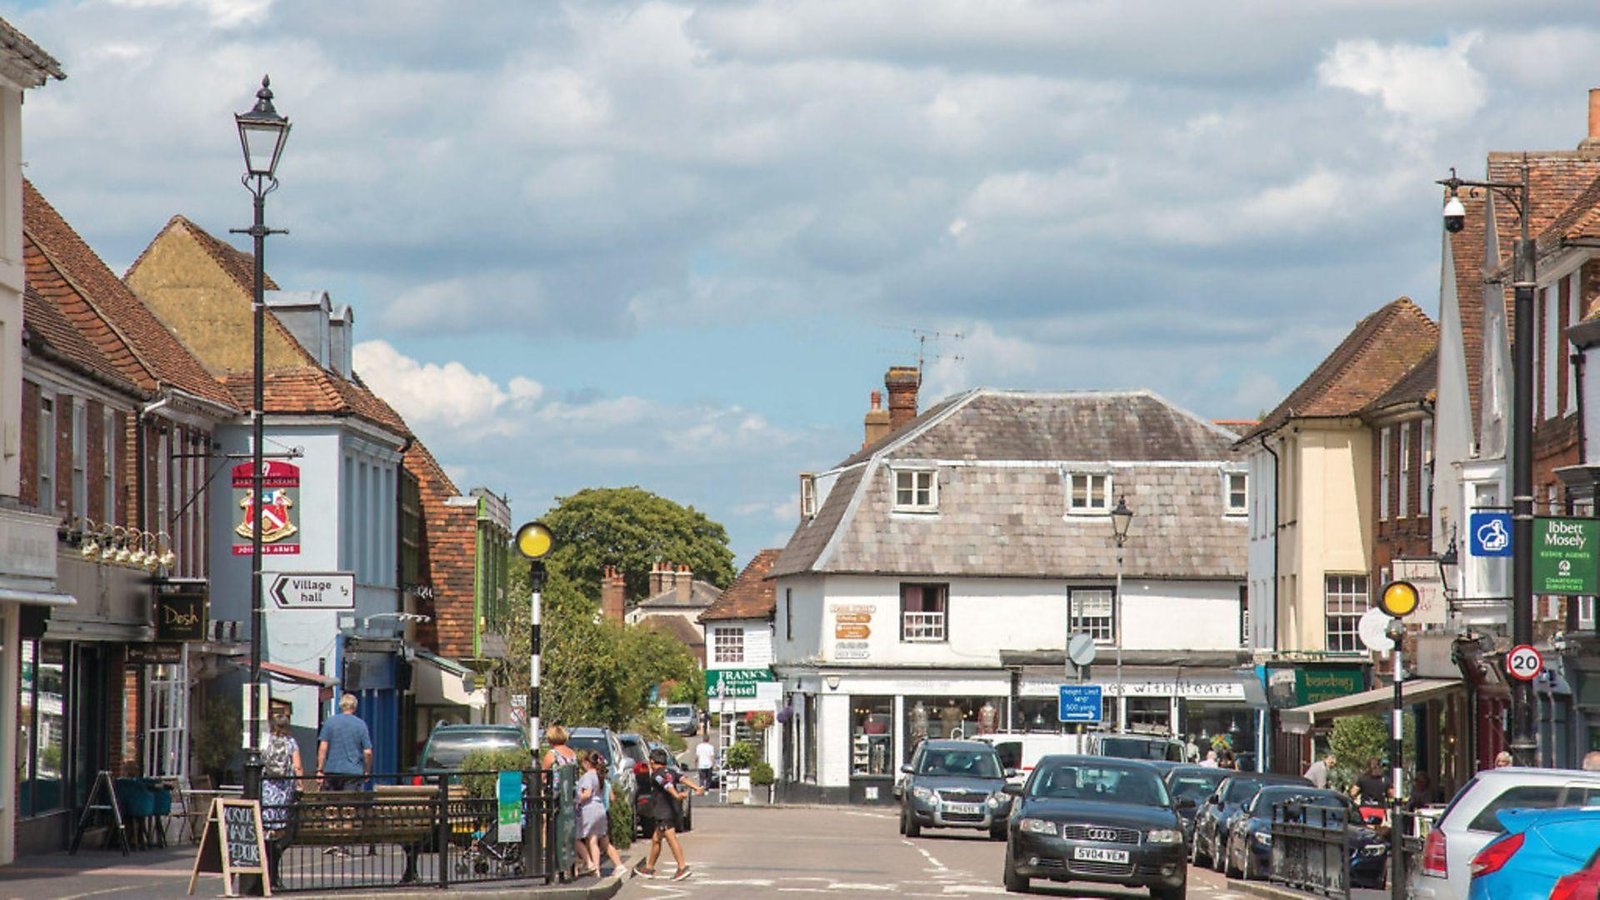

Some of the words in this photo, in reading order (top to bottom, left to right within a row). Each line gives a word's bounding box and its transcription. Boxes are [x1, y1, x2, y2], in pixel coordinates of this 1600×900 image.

[1548, 521, 1584, 535] Ibbett
[1544, 532, 1587, 551] Mosely
[293, 580, 332, 592] Village
[301, 592, 323, 602] hall
[1513, 655, 1538, 670] 20
[1135, 681, 1173, 694] with
[1305, 673, 1354, 692] bombay
[707, 685, 717, 696] &
[1061, 688, 1082, 697] Height
[1065, 703, 1079, 712] 500
[1080, 704, 1096, 712] yards
[1078, 848, 1104, 859] SV04
